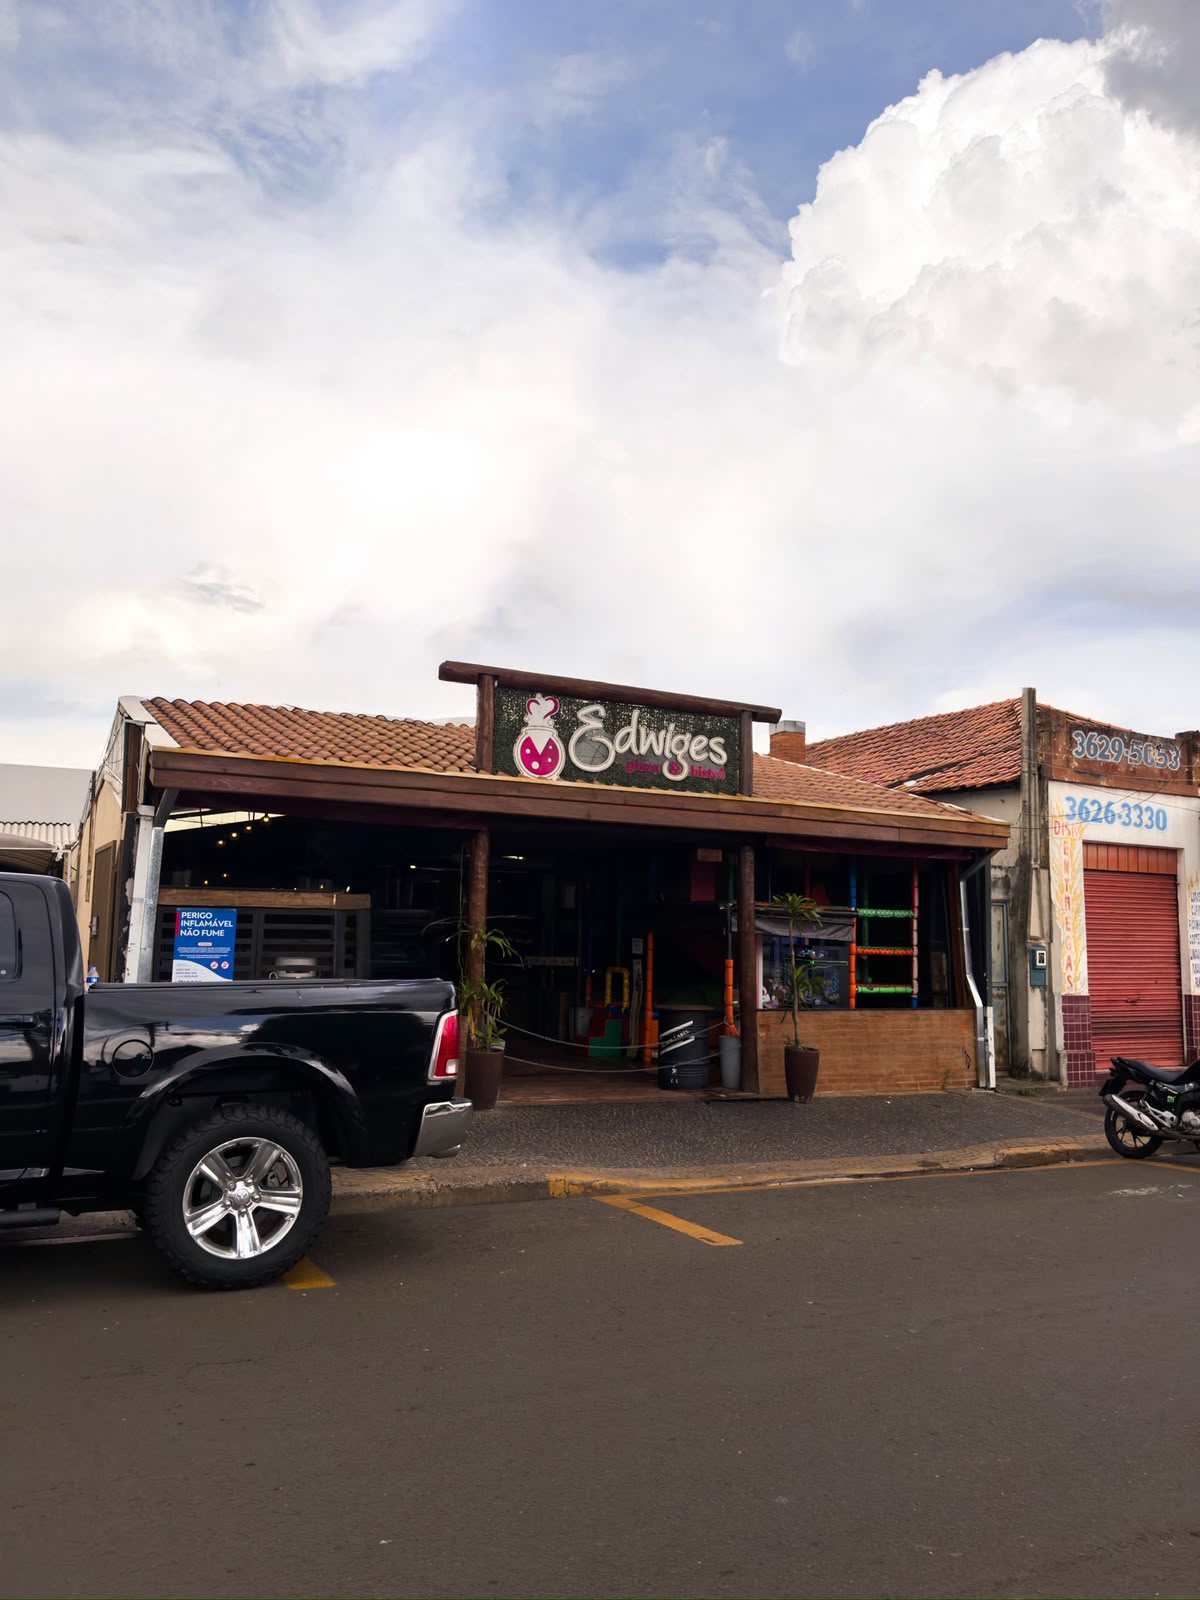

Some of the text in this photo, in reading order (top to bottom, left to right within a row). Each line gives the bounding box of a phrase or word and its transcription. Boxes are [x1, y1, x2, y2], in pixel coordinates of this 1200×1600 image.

[568, 704, 728, 781] Edwiges
[1072, 730, 1180, 771] 3629-5053
[1065, 796, 1167, 831] 3626-3330
[180, 928, 200, 936] NÃO
[181, 919, 233, 927] INFLAMÁVEL
